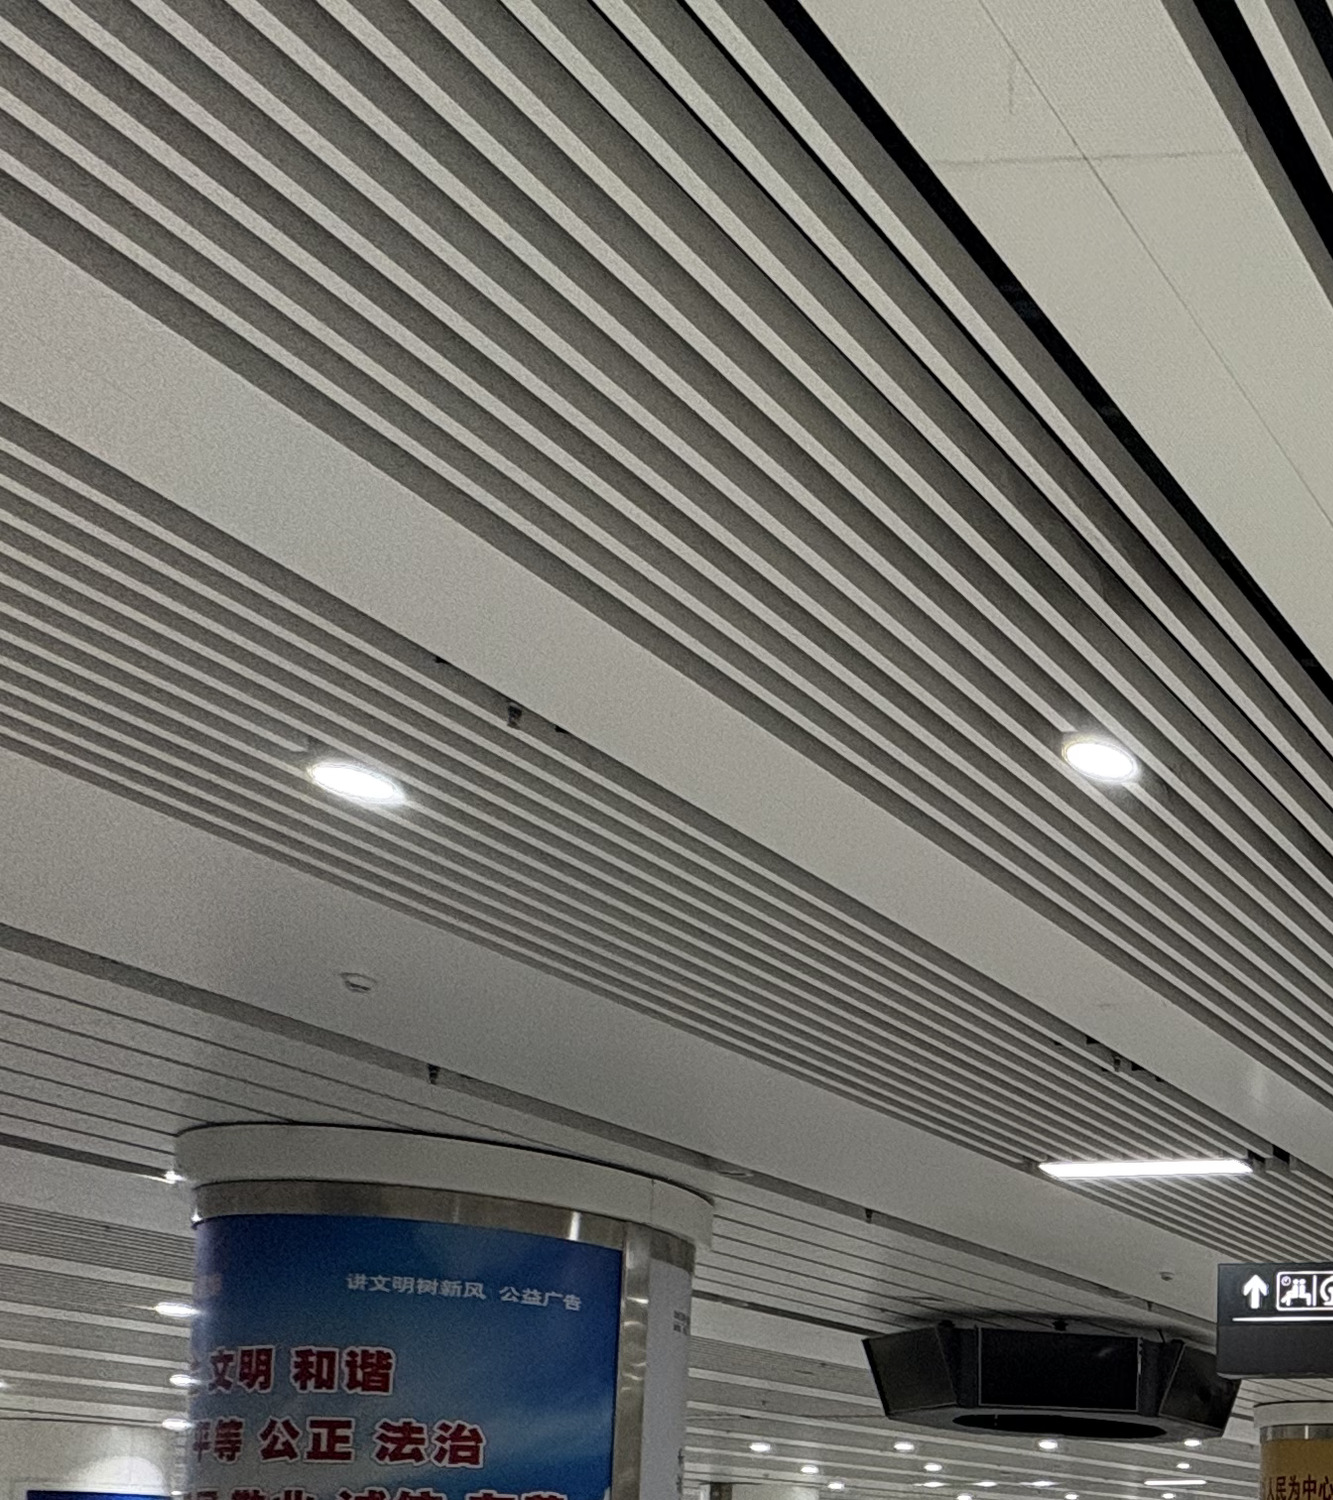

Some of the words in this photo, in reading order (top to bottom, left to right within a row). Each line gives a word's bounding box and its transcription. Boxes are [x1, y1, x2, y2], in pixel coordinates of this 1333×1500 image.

[347, 1272, 487, 1300] 讲文明树新风
[498, 1286, 582, 1311] 公益广告
[208, 1346, 274, 1393] 文明
[290, 1346, 395, 1395] 和谐
[258, 1416, 355, 1463] 公正
[373, 1419, 485, 1469] 法治
